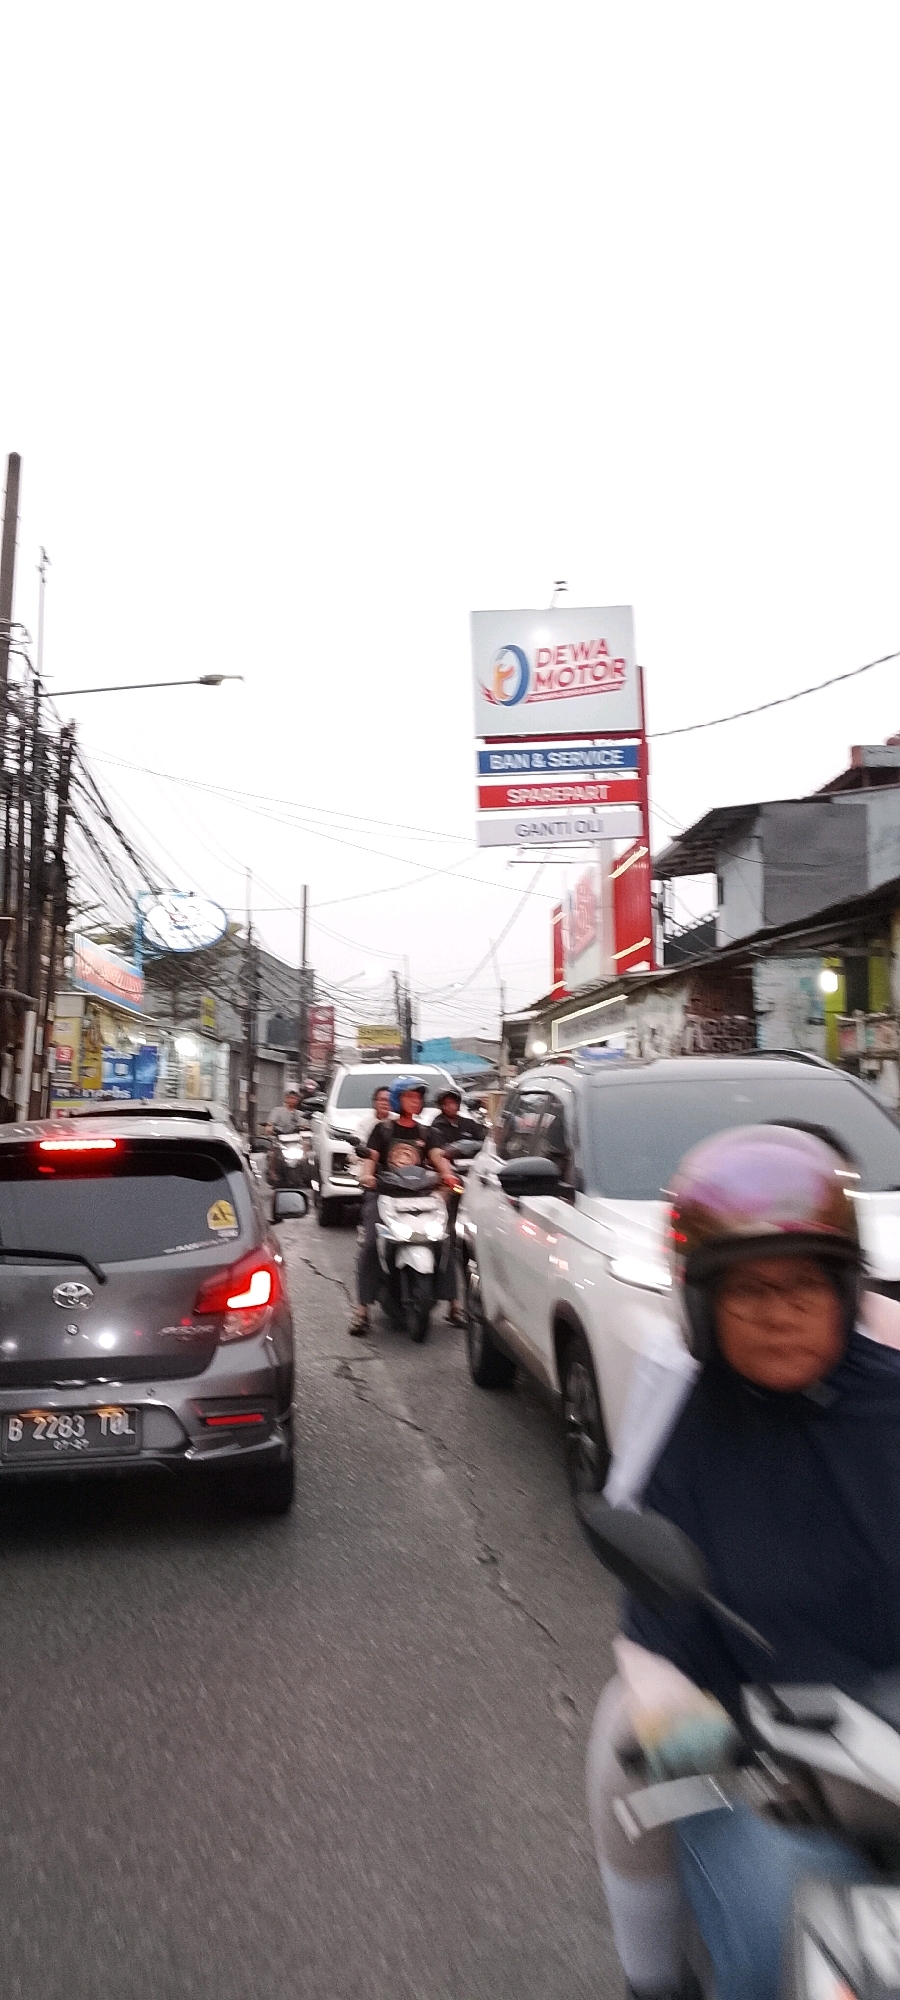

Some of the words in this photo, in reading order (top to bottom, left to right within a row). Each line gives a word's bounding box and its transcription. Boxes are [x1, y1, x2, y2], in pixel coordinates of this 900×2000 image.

[535, 638, 611, 668] DEWA
[533, 657, 627, 691] MOTOR
[489, 753, 530, 770] BAN
[530, 752, 547, 768] &
[547, 749, 624, 768] SERVICE
[506, 785, 612, 804] SPAREPART
[515, 821, 571, 838] GANTI
[574, 819, 604, 834] OLI
[8, 1416, 24, 1442] B
[32, 1414, 86, 1441] 2283
